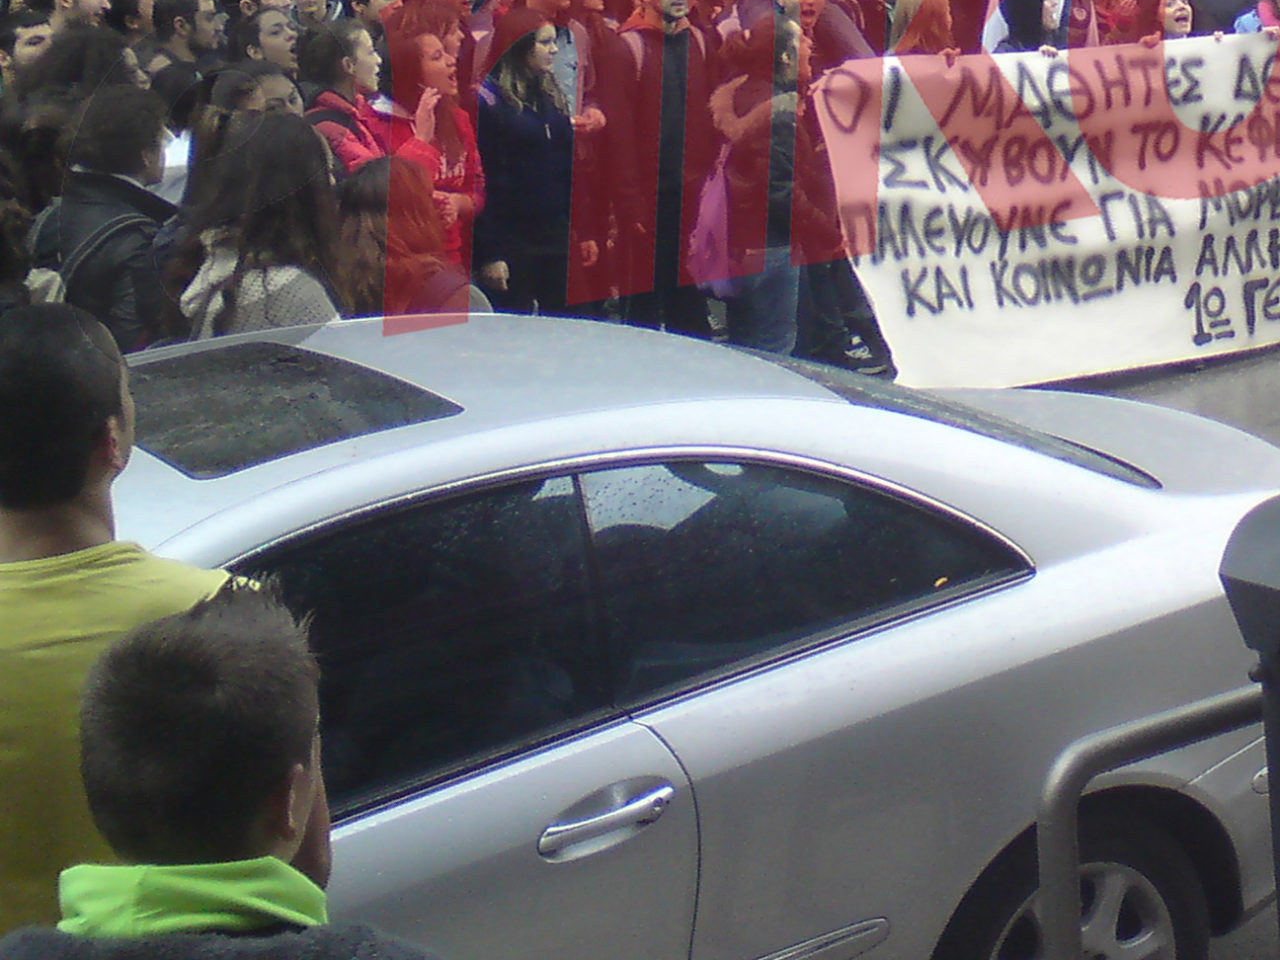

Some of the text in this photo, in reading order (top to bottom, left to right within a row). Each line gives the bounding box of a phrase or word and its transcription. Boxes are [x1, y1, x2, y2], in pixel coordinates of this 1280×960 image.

[823, 66, 900, 134] ΟΙ
[939, 55, 1203, 130] ΜΑΘΗΤΕΣ
[1130, 120, 1180, 171] ΤΟ
[1099, 190, 1177, 241] ΓΙΑ
[901, 264, 976, 317] ΚΑΙ
[990, 244, 1178, 309] ΚΟΙΝΩΝΙΑ
